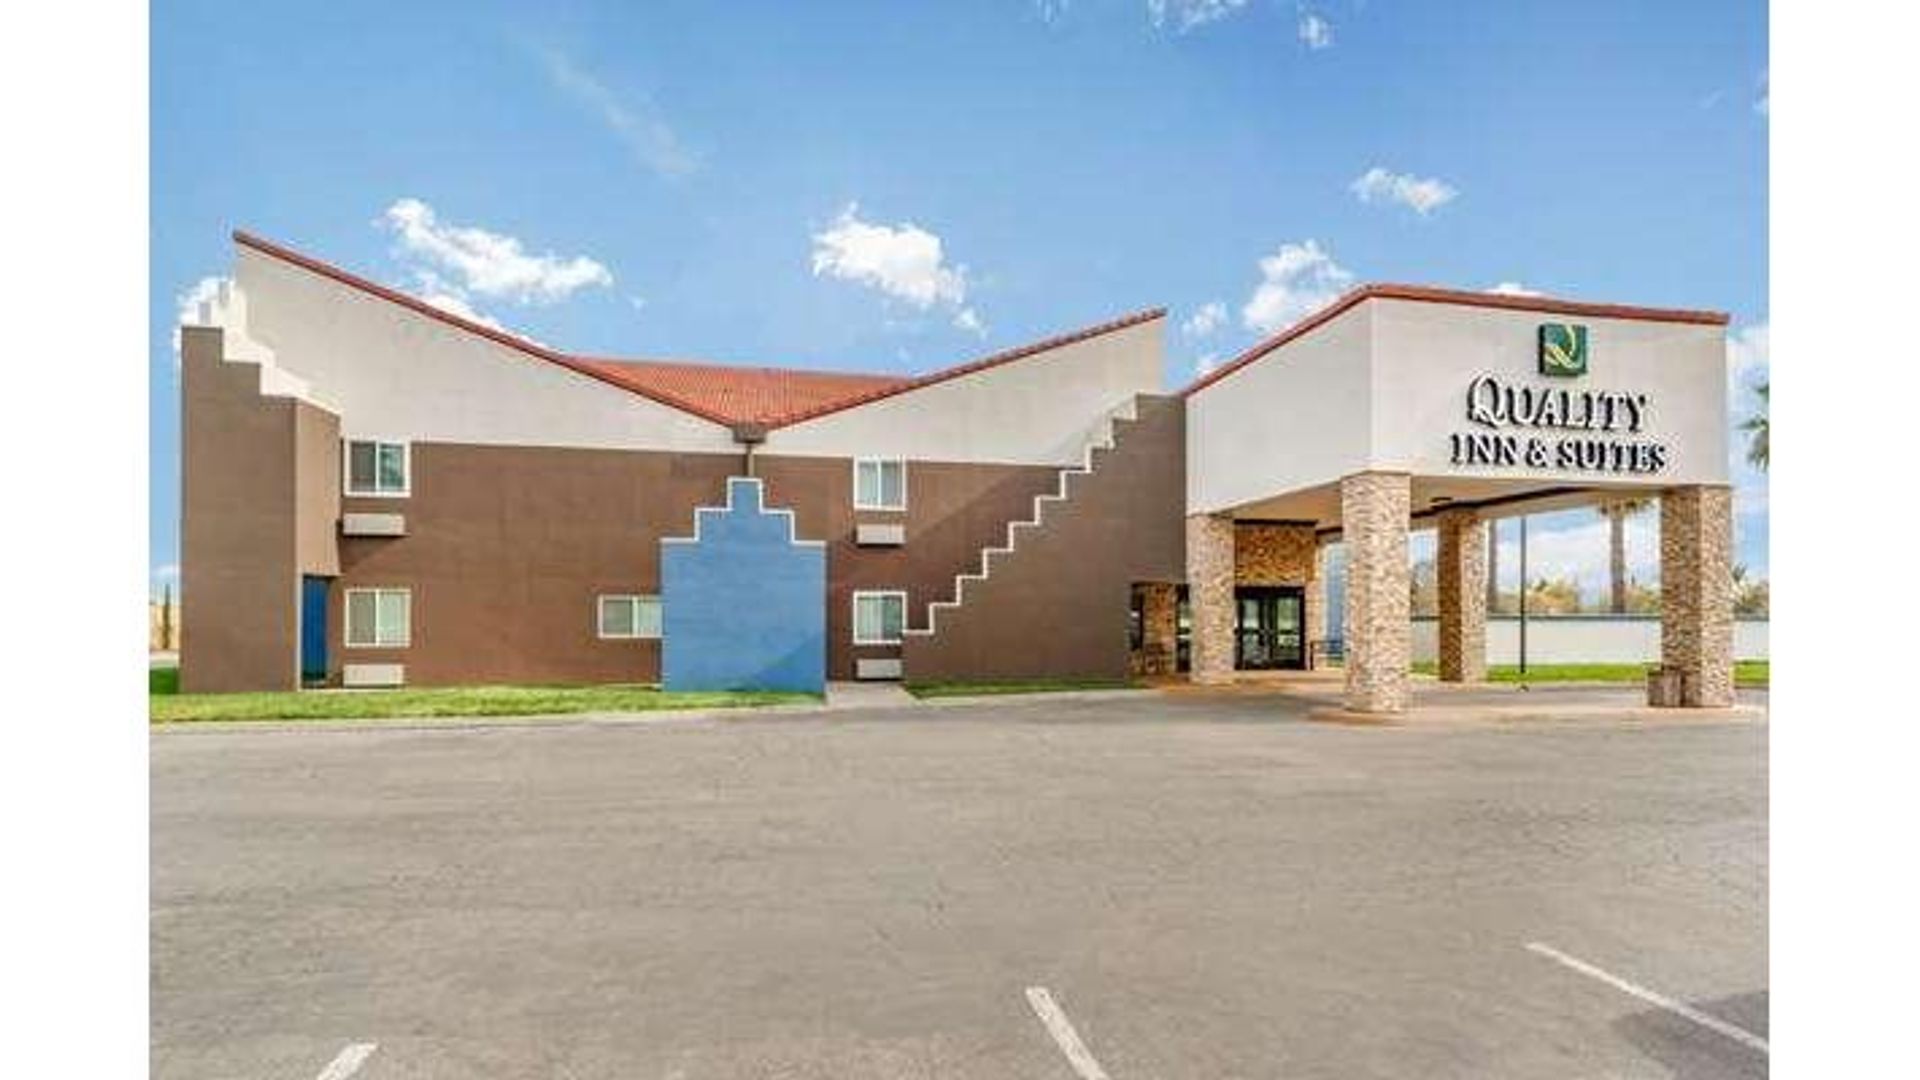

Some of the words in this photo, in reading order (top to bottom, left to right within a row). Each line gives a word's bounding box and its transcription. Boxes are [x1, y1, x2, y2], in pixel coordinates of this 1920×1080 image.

[1467, 374, 1646, 432] QUALITY
[1450, 433, 1517, 466] INN
[1524, 437, 1547, 468] &
[1556, 440, 1666, 473] SUITES
